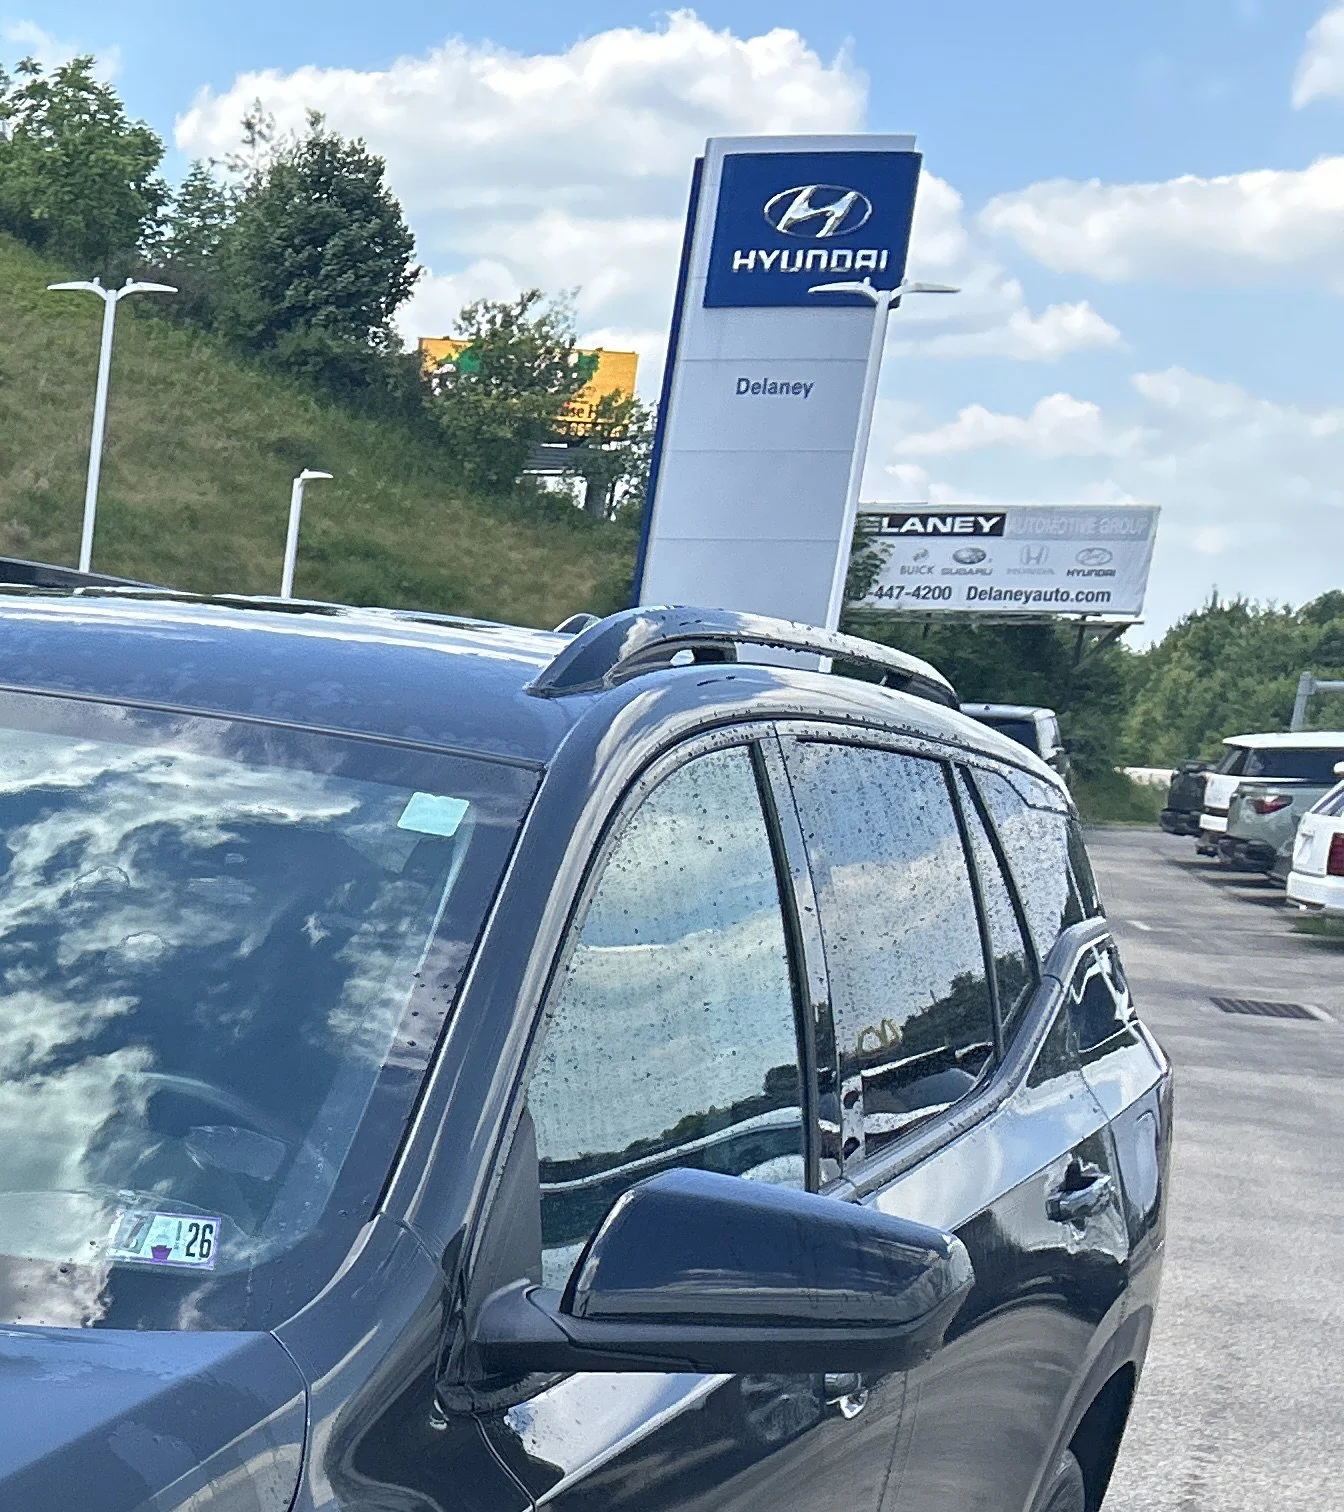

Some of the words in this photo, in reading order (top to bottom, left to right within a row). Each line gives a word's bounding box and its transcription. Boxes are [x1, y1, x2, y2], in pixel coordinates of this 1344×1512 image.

[732, 248, 890, 273] HYUNDAI
[736, 377, 814, 399] Delaney
[862, 515, 1002, 533] ELANEY
[900, 564, 935, 576] BUICK
[1066, 568, 1117, 578] HYUNDAI
[966, 584, 1112, 605] Delaneyauto.com
[185, 1222, 214, 1259] 26
